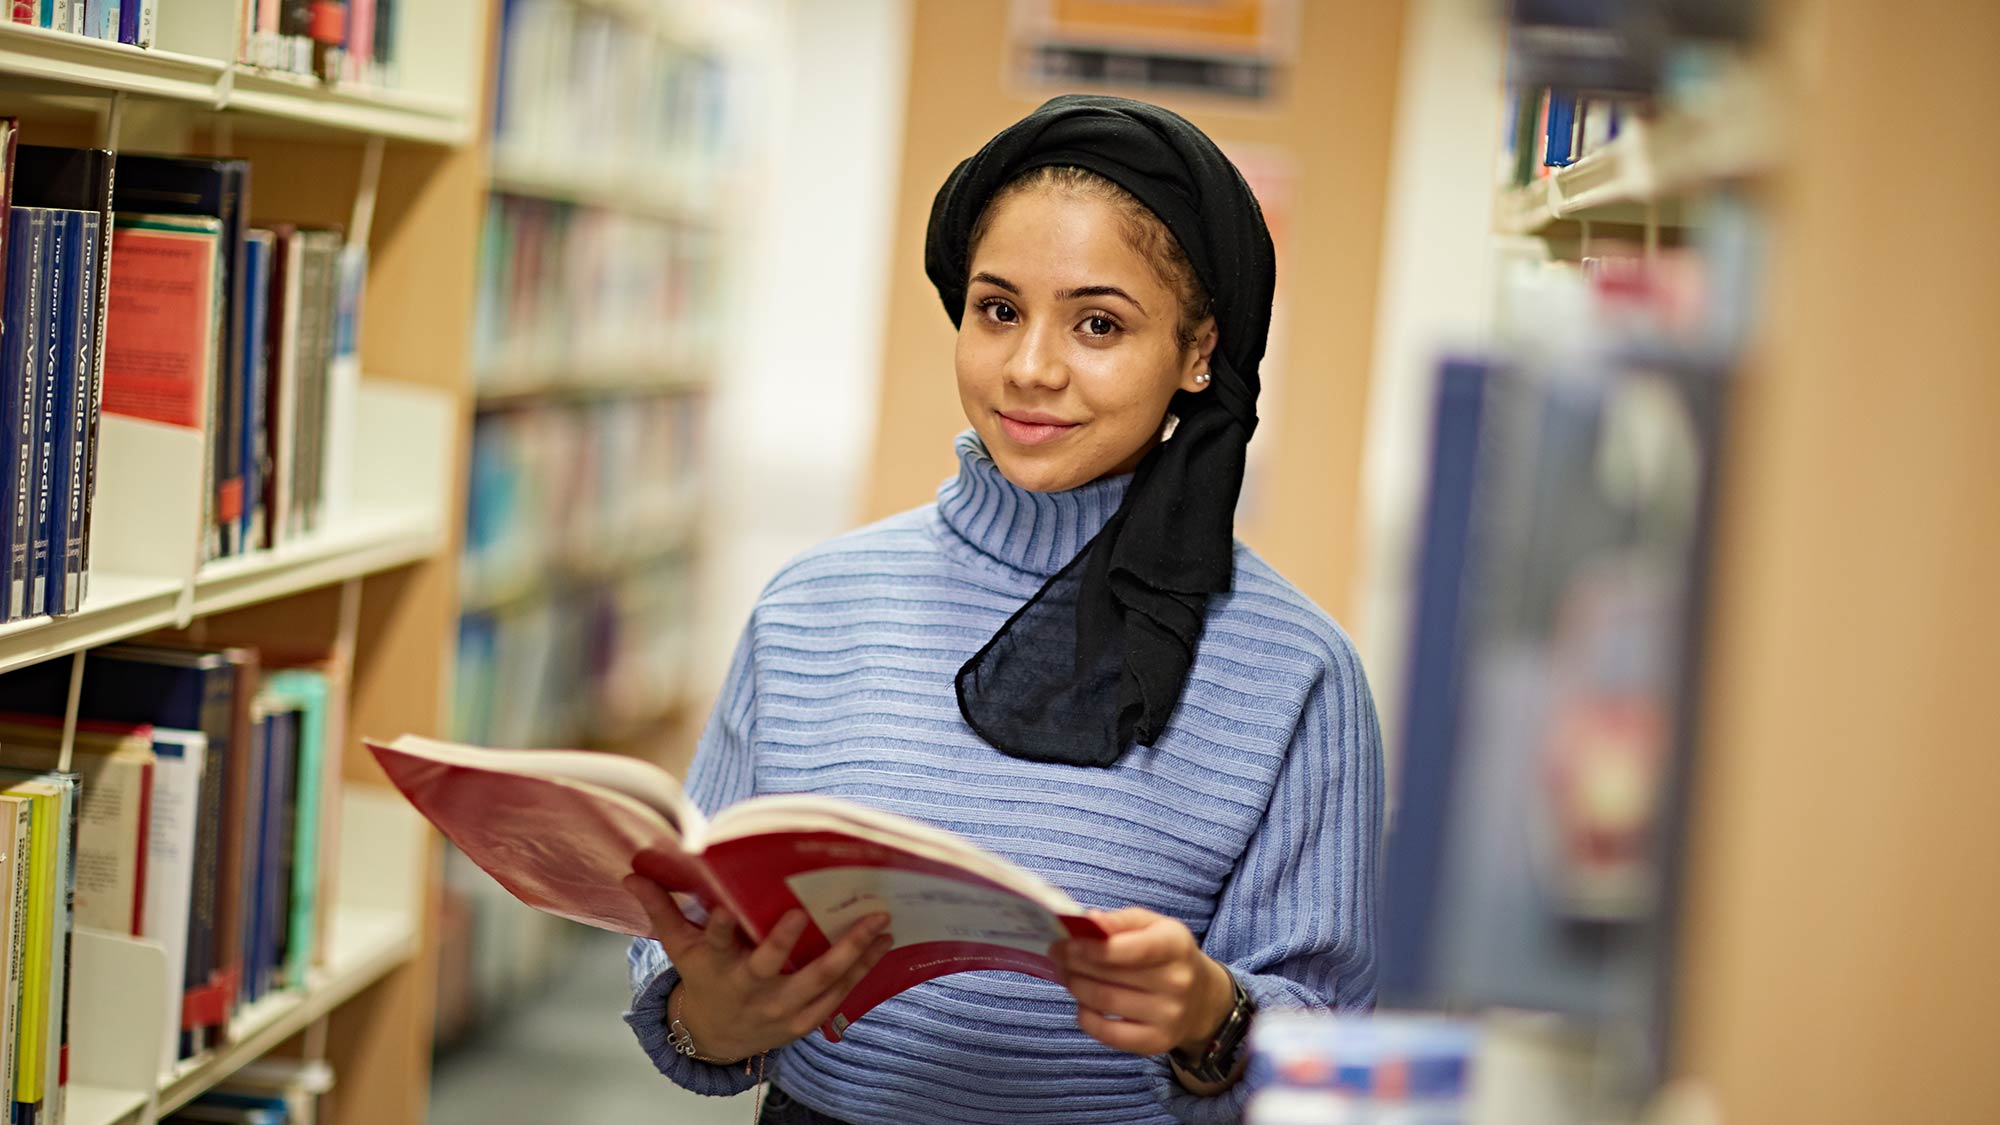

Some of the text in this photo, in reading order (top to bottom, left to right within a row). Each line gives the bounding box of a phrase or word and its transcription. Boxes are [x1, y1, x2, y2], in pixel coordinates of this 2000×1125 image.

[85, 236, 93, 266] The
[52, 268, 60, 318] Repair
[83, 270, 91, 319] Repair
[90, 168, 115, 425] COLLISION REPAIR FUNDAMENTALS
[22, 344, 34, 435] Vehicle
[44, 343, 56, 433] Vehicle
[76, 344, 88, 433] Vehicle
[17, 444, 29, 527] Bodies
[39, 442, 51, 524] Bodies
[71, 441, 83, 522] Bodies
[908, 957, 952, 972] Charles
